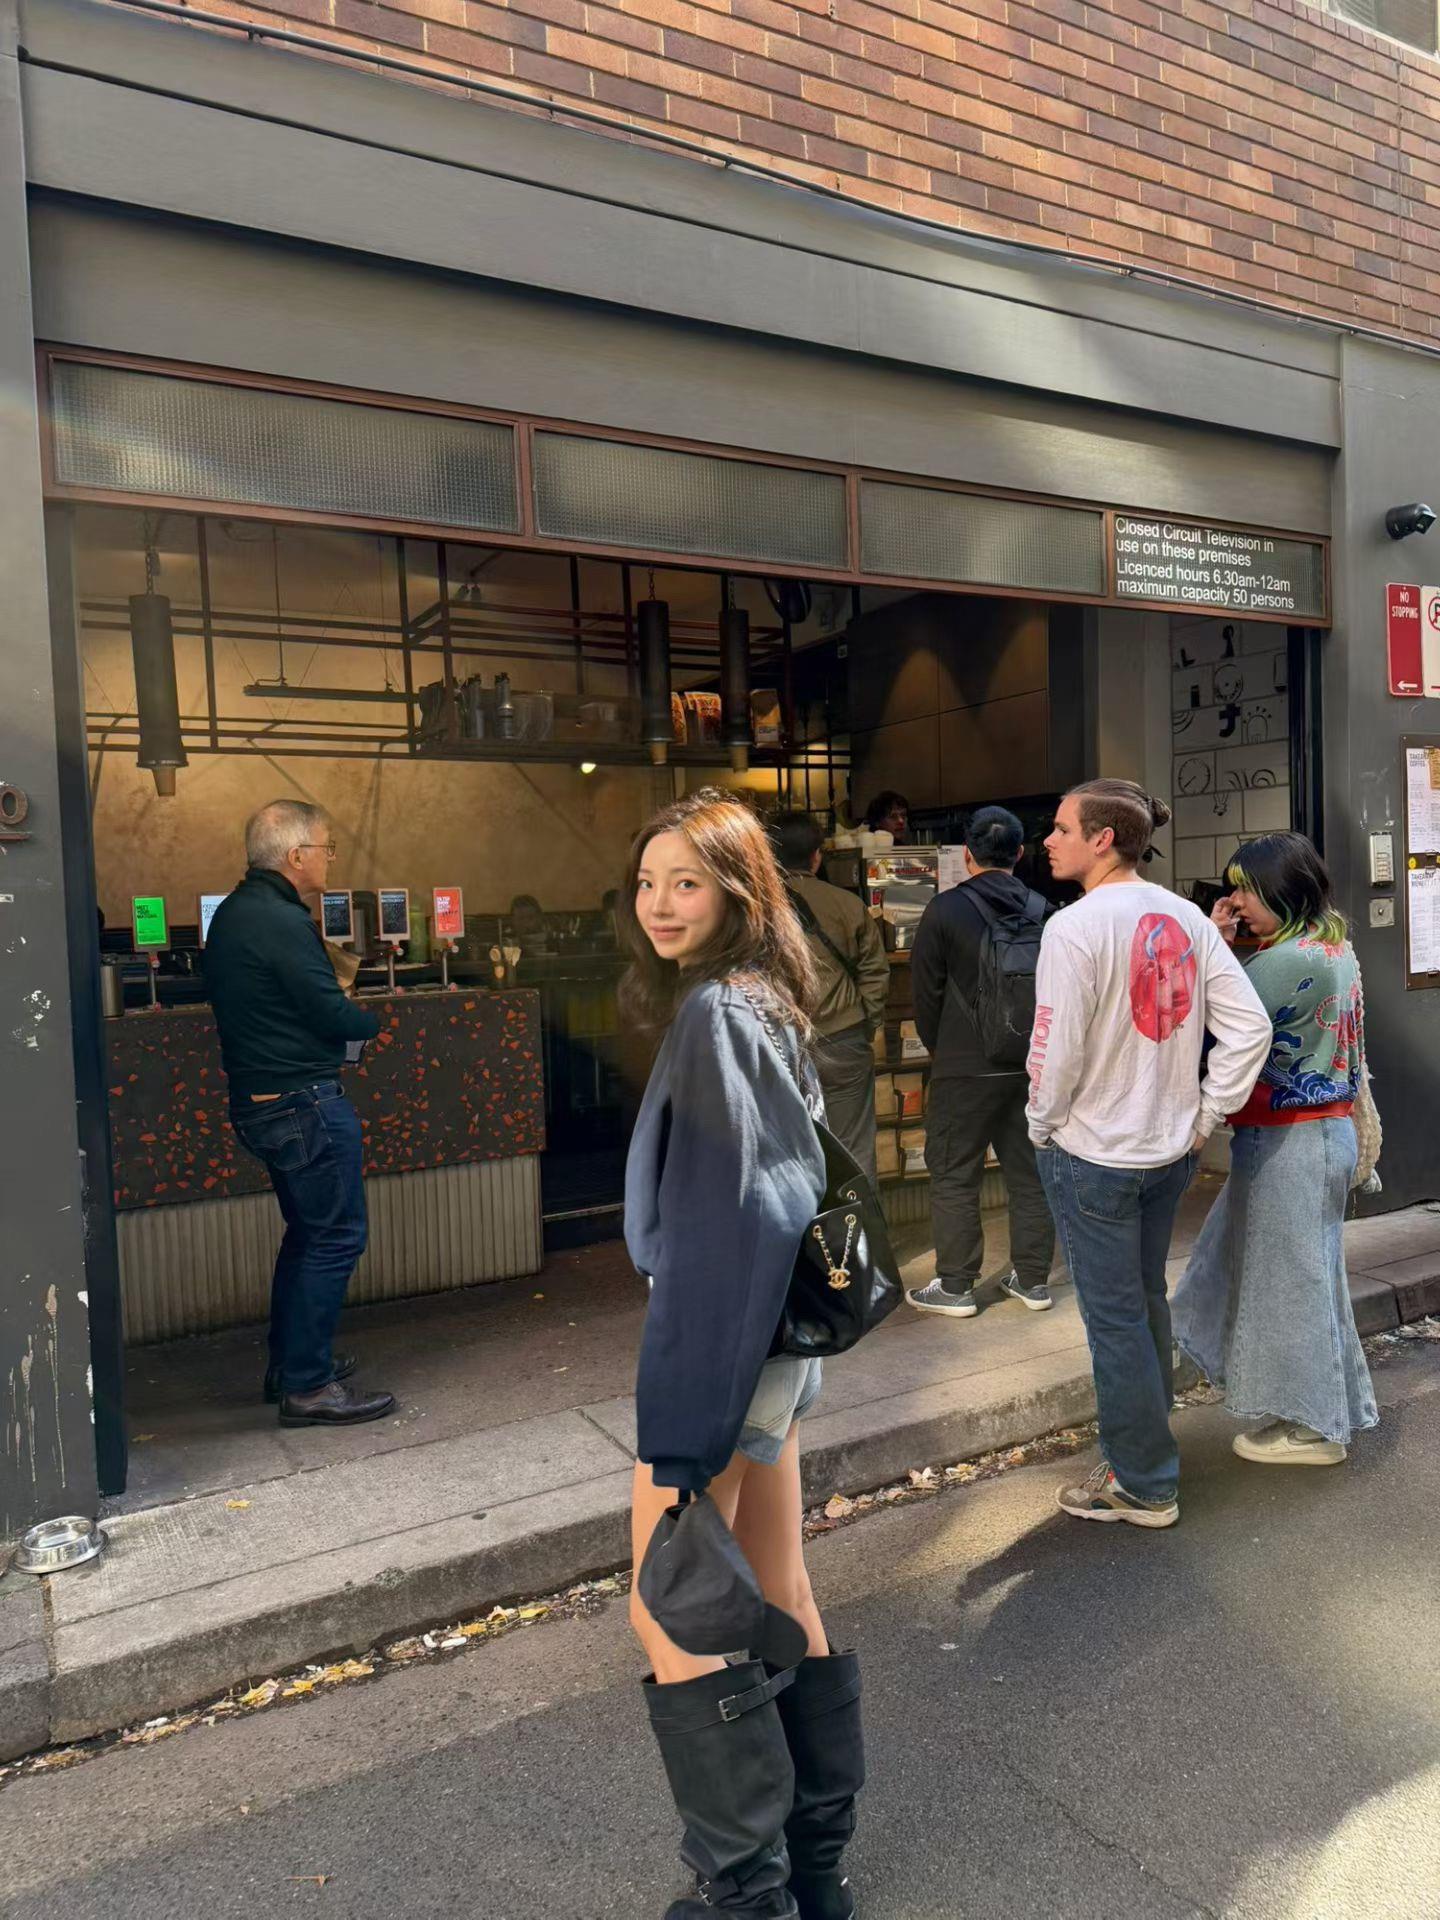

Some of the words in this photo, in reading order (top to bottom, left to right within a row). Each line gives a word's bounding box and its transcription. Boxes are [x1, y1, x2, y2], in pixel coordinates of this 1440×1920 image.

[1115, 517, 1160, 538] Closed
[1163, 523, 1202, 543] Circuit
[1205, 529, 1260, 551] Television
[1263, 537, 1274, 553] in
[1116, 539, 1139, 553] use
[1142, 541, 1158, 555] on
[1162, 541, 1196, 560] these
[1199, 549, 1252, 567] premises
[1116, 557, 1173, 579] Licenced
[1176, 564, 1210, 583] hours
[1213, 568, 1291, 592] 6.30am-12am
[1117, 578, 1179, 598] maximum
[1181, 586, 1230, 606] capacity
[1233, 588, 1248, 604] 50
[1250, 593, 1295, 609] persons
[1399, 591, 1410, 603] NO
[1391, 605, 1419, 619] STOPPING
